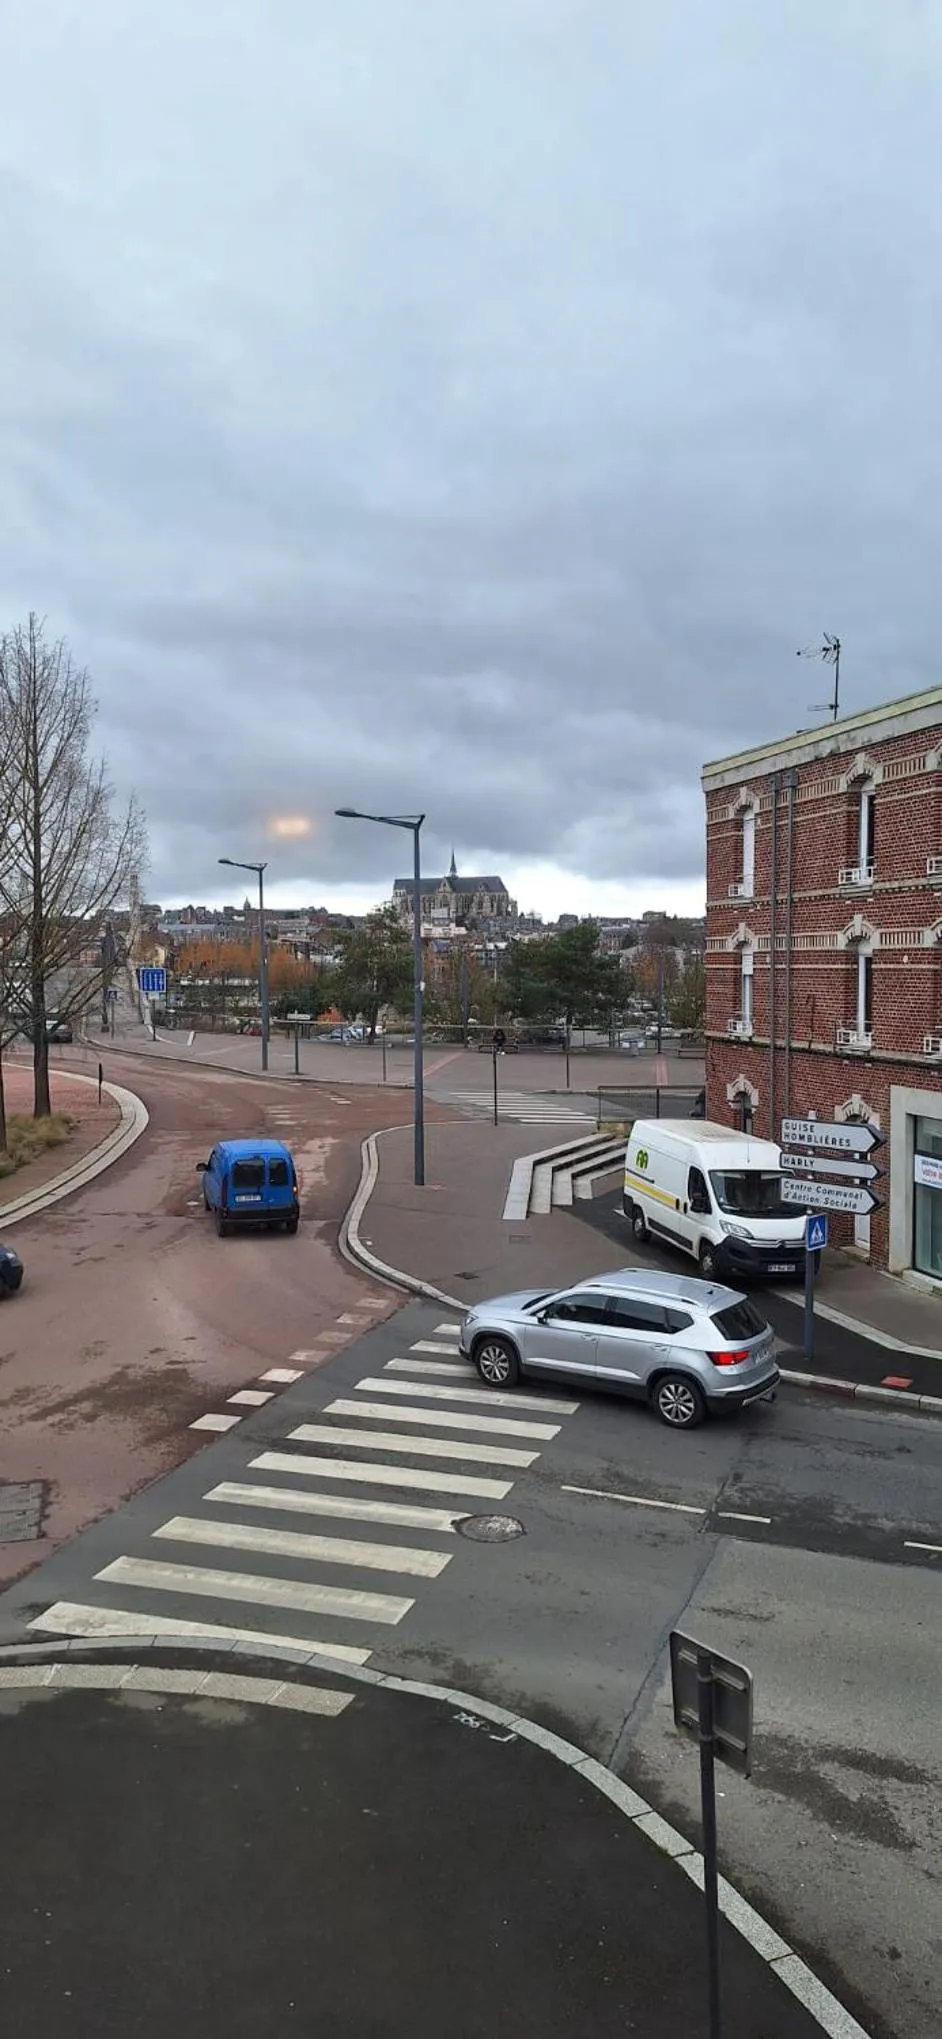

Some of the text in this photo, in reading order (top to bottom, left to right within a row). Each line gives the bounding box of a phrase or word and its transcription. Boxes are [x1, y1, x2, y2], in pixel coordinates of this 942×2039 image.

[784, 1122, 815, 1133] GUISE
[784, 1156, 815, 1168] HARLY
[783, 1180, 863, 1200] Centre Communal
[783, 1191, 857, 1209] d'Action Sociale
